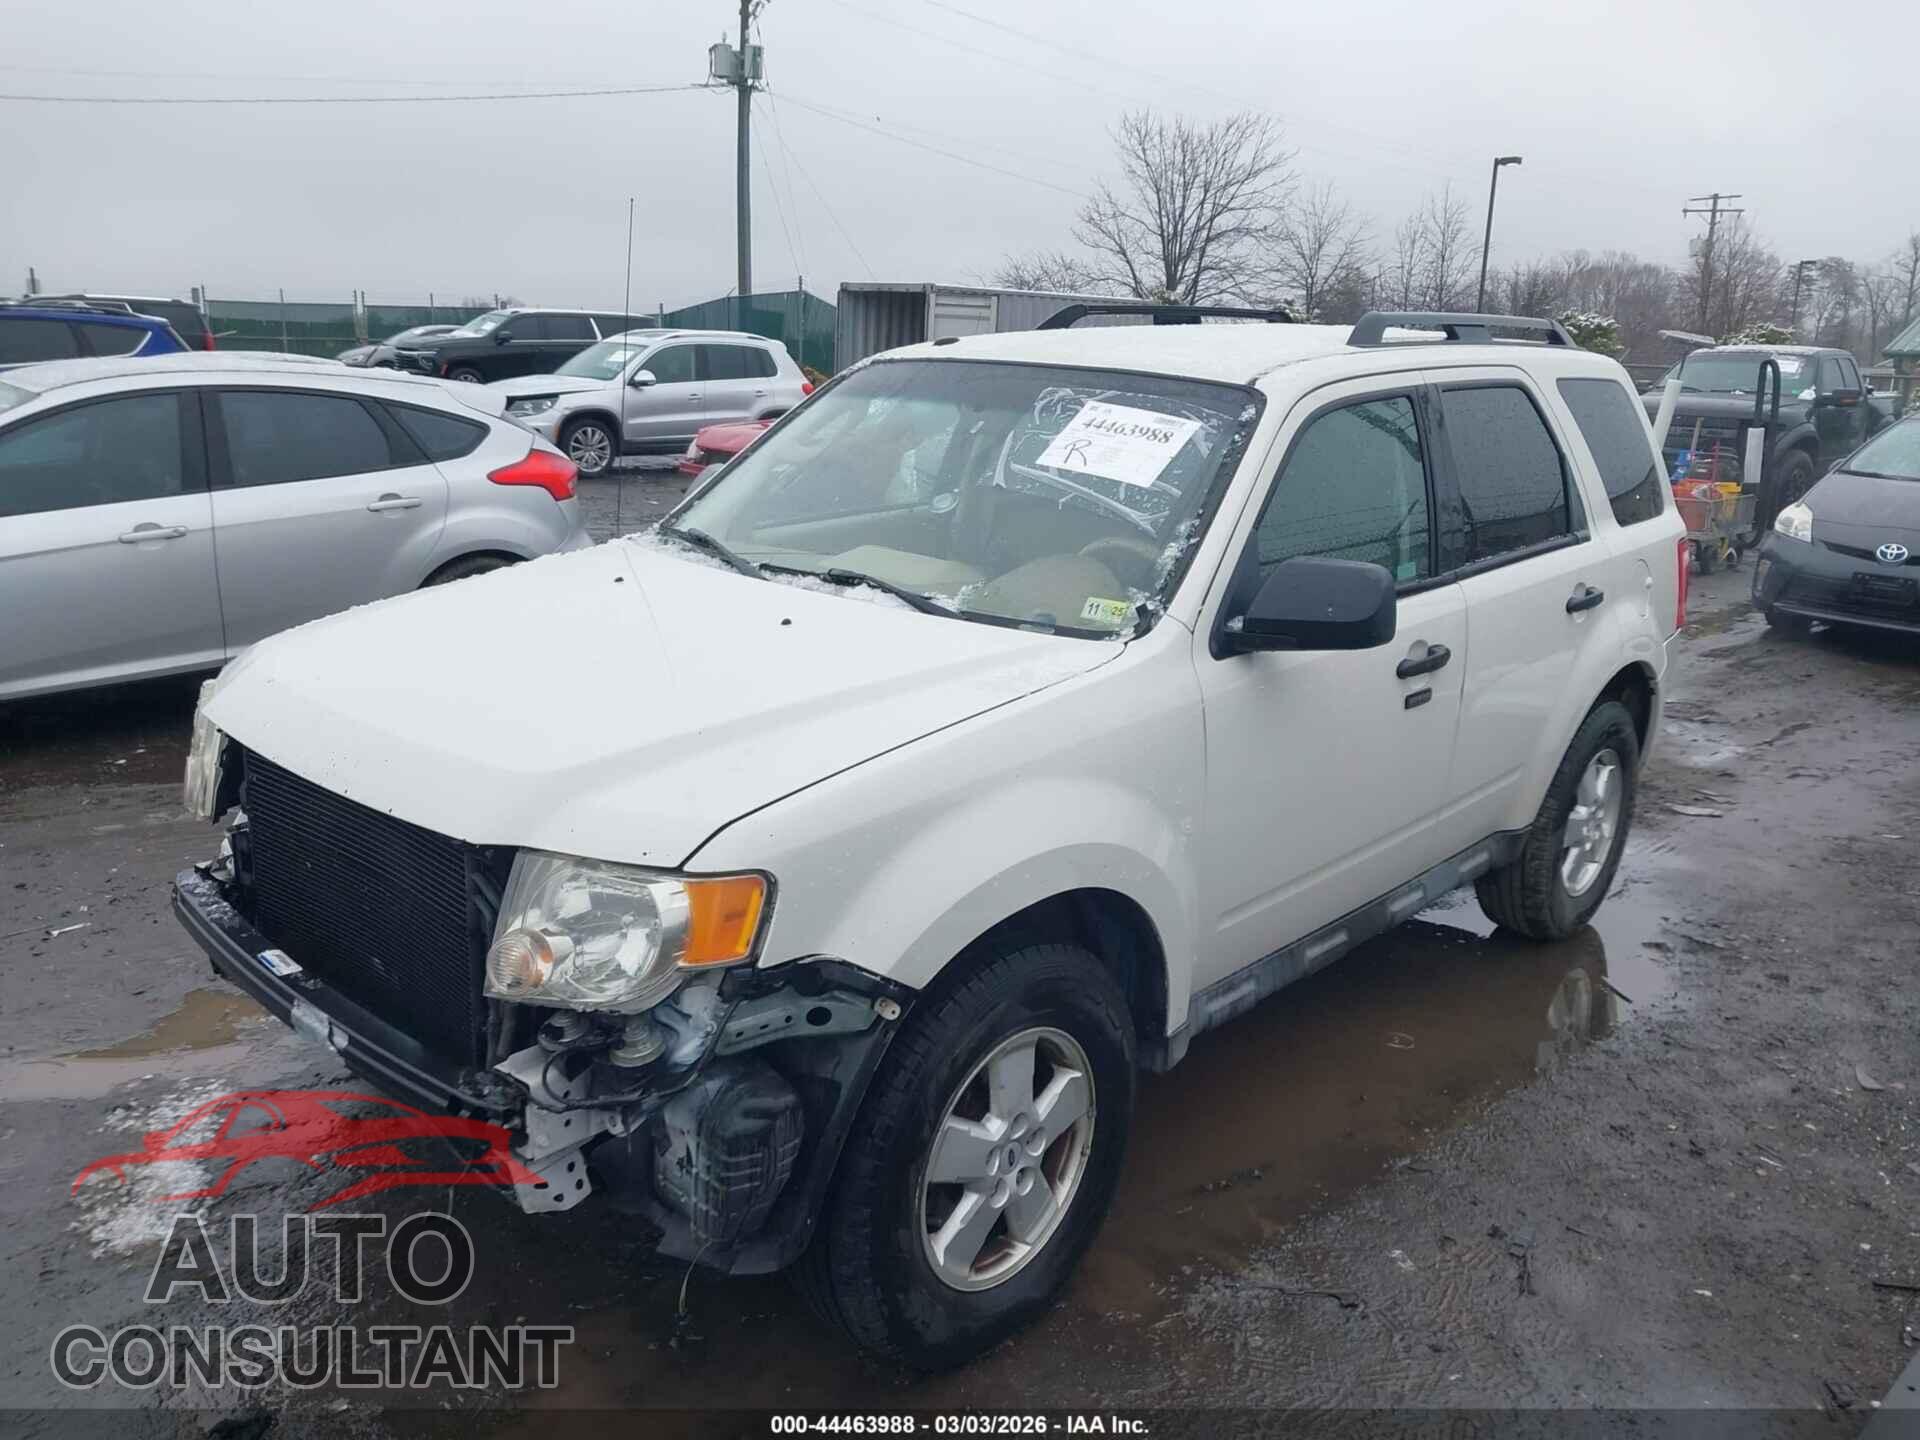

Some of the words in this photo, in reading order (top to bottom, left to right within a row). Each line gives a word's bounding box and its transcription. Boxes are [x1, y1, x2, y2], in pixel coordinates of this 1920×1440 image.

[1082, 416, 1175, 444] 44463988
[1063, 439, 1093, 467] R
[1088, 602, 1101, 616] 11
